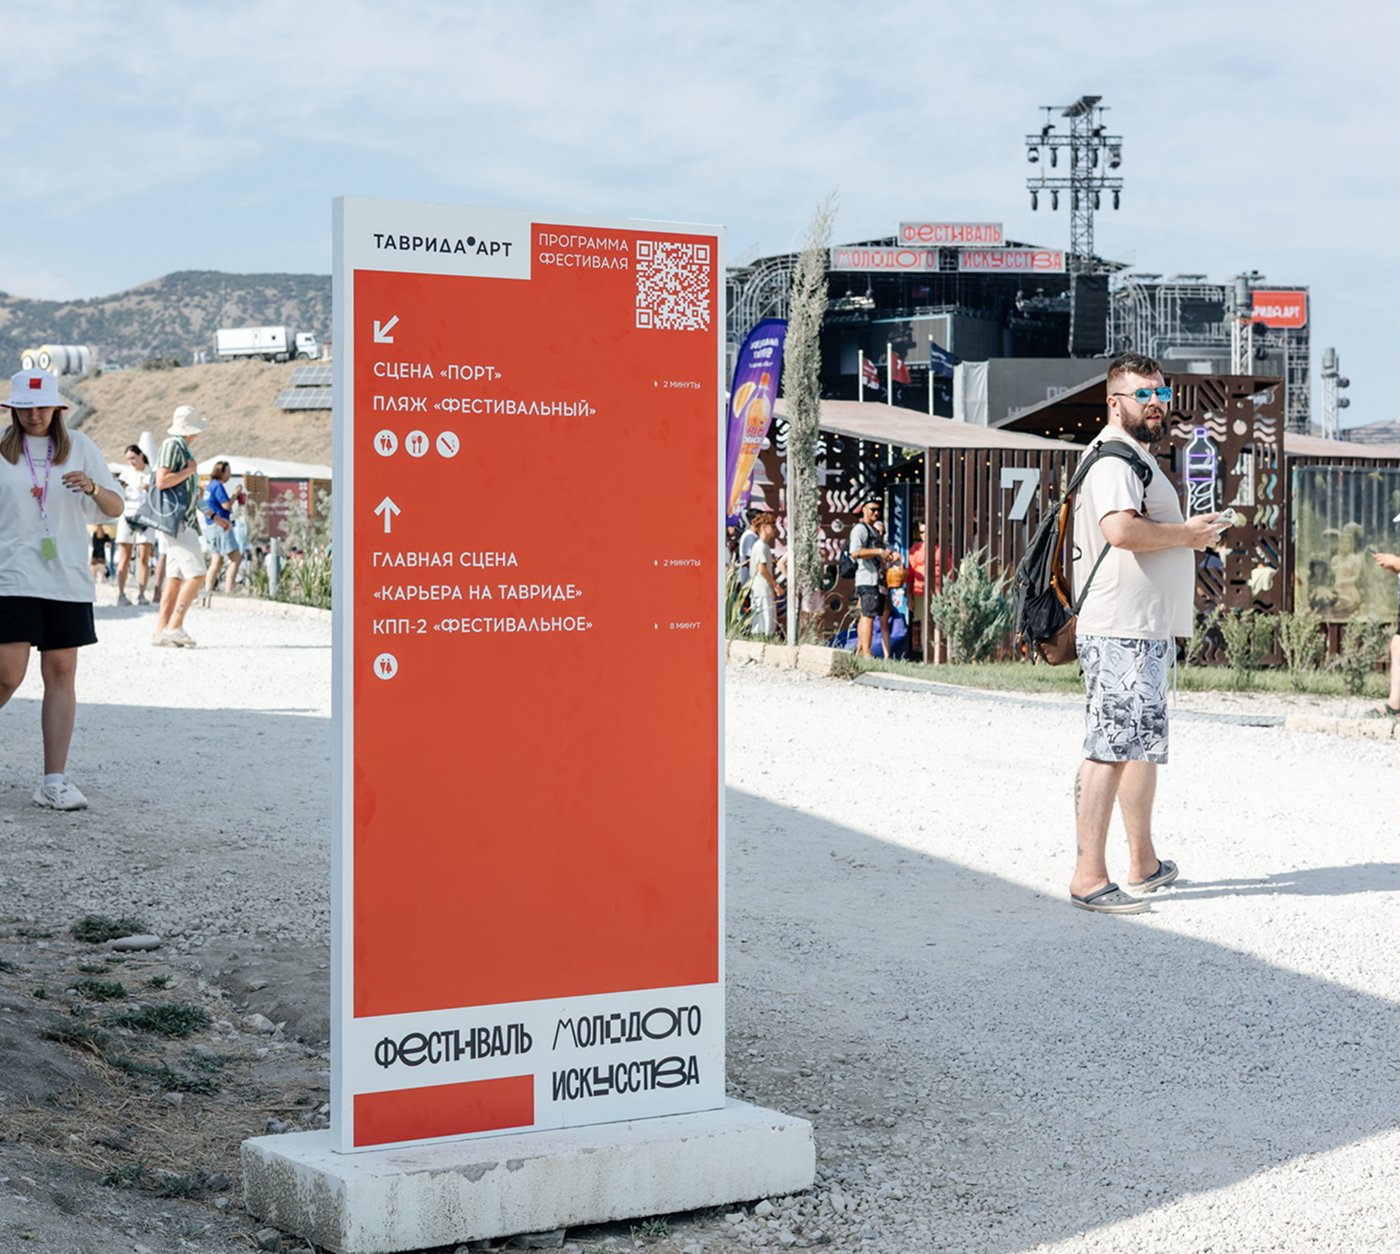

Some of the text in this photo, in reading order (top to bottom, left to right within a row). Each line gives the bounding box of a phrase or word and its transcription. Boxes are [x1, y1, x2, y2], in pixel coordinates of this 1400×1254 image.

[539, 233, 629, 252] ПРОГРАММА
[538, 252, 629, 270] ФЕСТИВАЛЯ
[963, 250, 1062, 269] ИСКУССТВА
[373, 362, 502, 381] СЦЕНА «ПОРТ»
[663, 380, 701, 390] 2 МИНУТЫ
[373, 395, 597, 418] ПЛЯЖ «ФЕСТИВАЛЬНЫЙ»
[1001, 467, 1041, 521] 7
[373, 551, 518, 569] ГЛАВНАЯ СЦЕНА
[663, 558, 701, 568] 2 МИНУТЫ
[373, 584, 583, 602] «КАРЬЕРА НА ТАВРИДЕ»
[373, 616, 593, 635] КПП-2 «ФЕСТИВАЛЬНОЕ»
[669, 621, 701, 631] 8 МИНУТ
[552, 1005, 702, 1051] МОЛОДОГО
[552, 1055, 700, 1101] ИСКУССТВА
